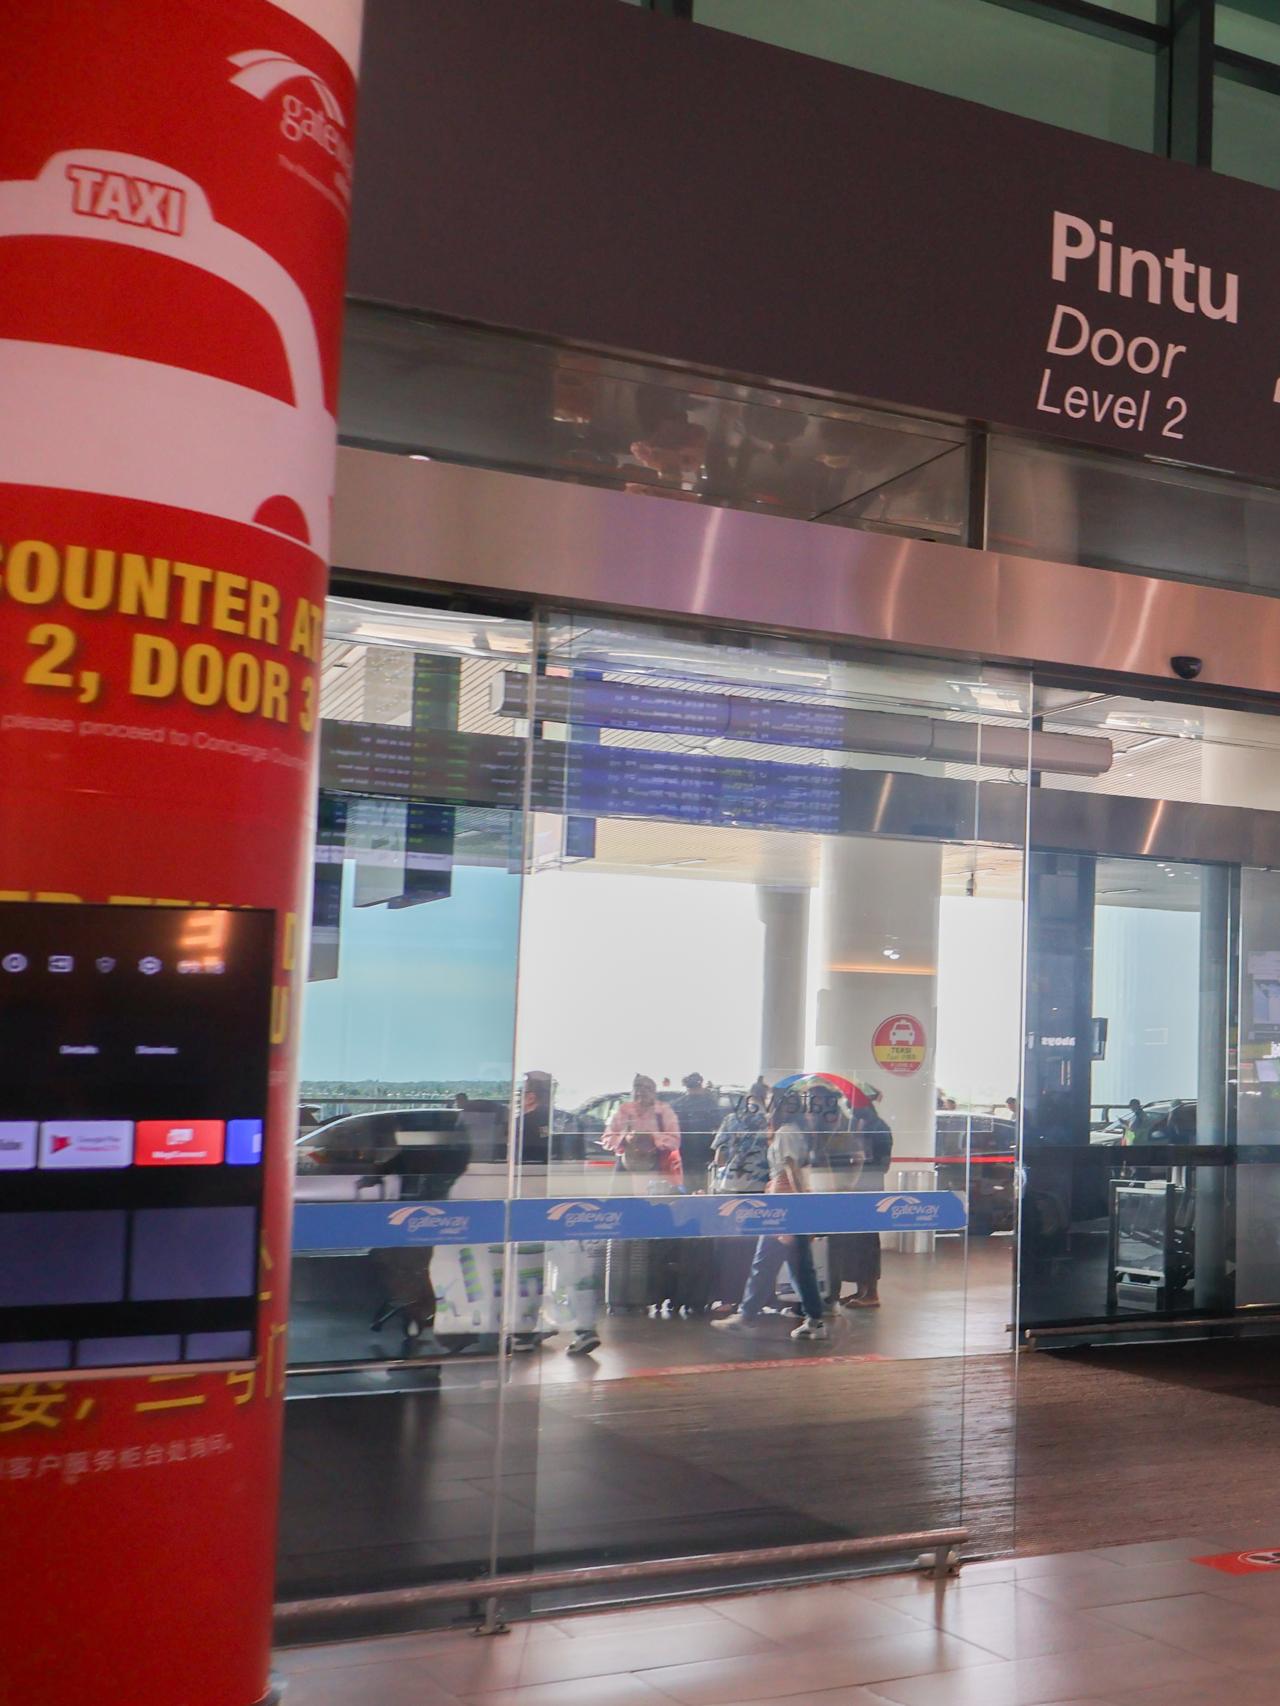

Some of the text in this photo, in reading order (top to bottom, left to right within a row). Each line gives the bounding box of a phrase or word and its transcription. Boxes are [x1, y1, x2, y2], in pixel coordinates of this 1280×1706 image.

[66, 163, 187, 237] TAXI
[1052, 211, 1239, 323] Pintu
[1046, 304, 1187, 379] Door
[1037, 369, 1188, 439] Level 2
[0, 539, 282, 647] OUNTER
[23, 623, 314, 733] 2, DOOR 3
[407, 1213, 469, 1233] gateway
[564, 1210, 622, 1227] gateway
[891, 1203, 938, 1219] gateway
